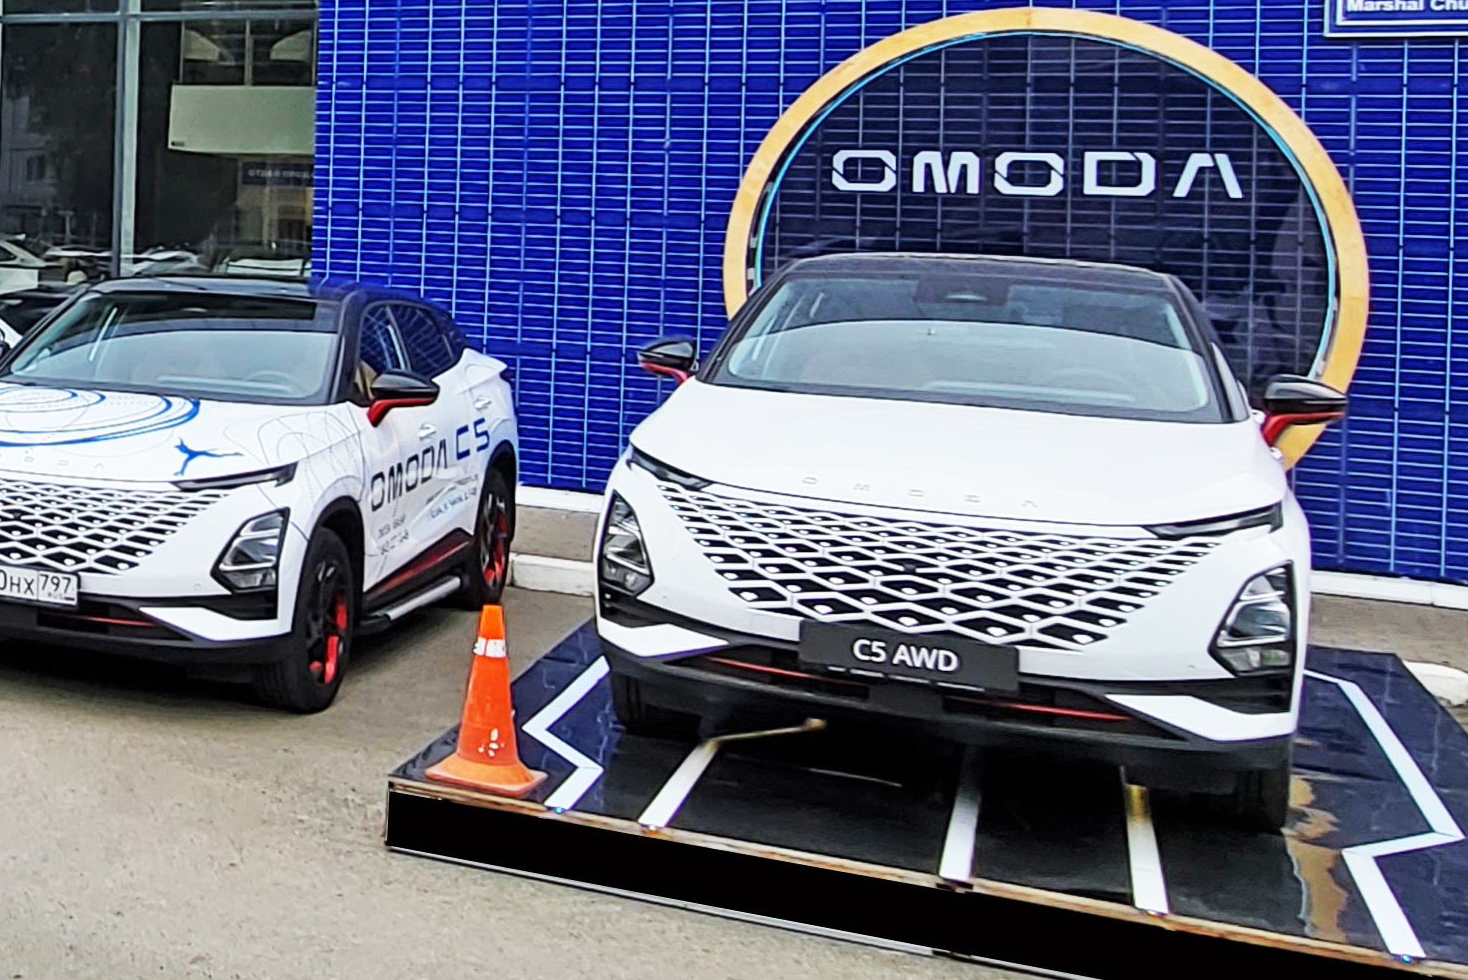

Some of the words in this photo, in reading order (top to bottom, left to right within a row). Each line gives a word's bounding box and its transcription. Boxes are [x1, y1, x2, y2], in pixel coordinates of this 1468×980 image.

[831, 149, 1244, 199] OMODA
[371, 438, 448, 512] OMODA
[456, 417, 491, 461] C5
[39, 573, 72, 594] 797
[853, 638, 887, 663] C5
[892, 644, 960, 671] AWD
